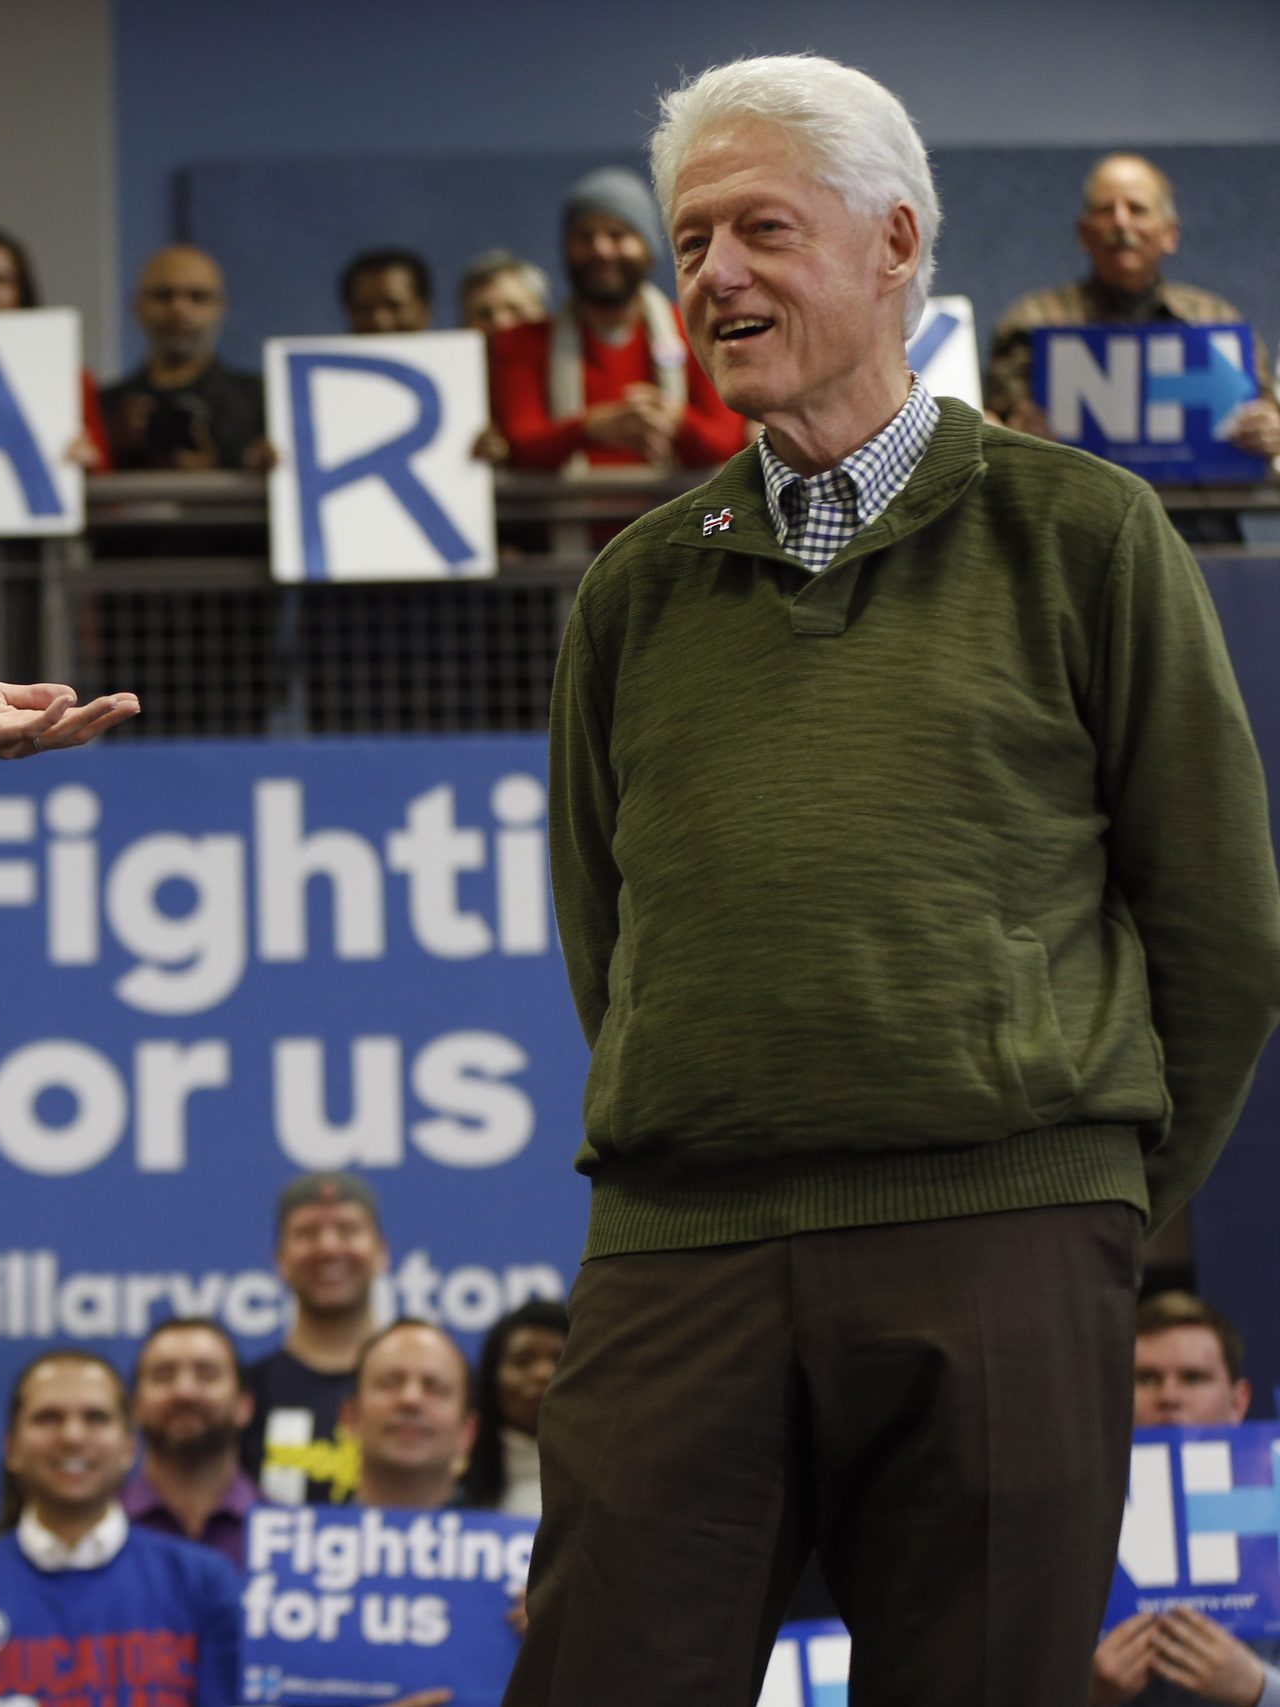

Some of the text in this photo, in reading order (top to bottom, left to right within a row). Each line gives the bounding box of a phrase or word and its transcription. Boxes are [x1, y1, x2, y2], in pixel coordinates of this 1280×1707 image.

[1047, 331, 1258, 444] NH
[287, 352, 478, 581] R
[273, 1030, 534, 1170] us
[248, 1508, 534, 1595] Fighting
[243, 1573, 450, 1649] for us
